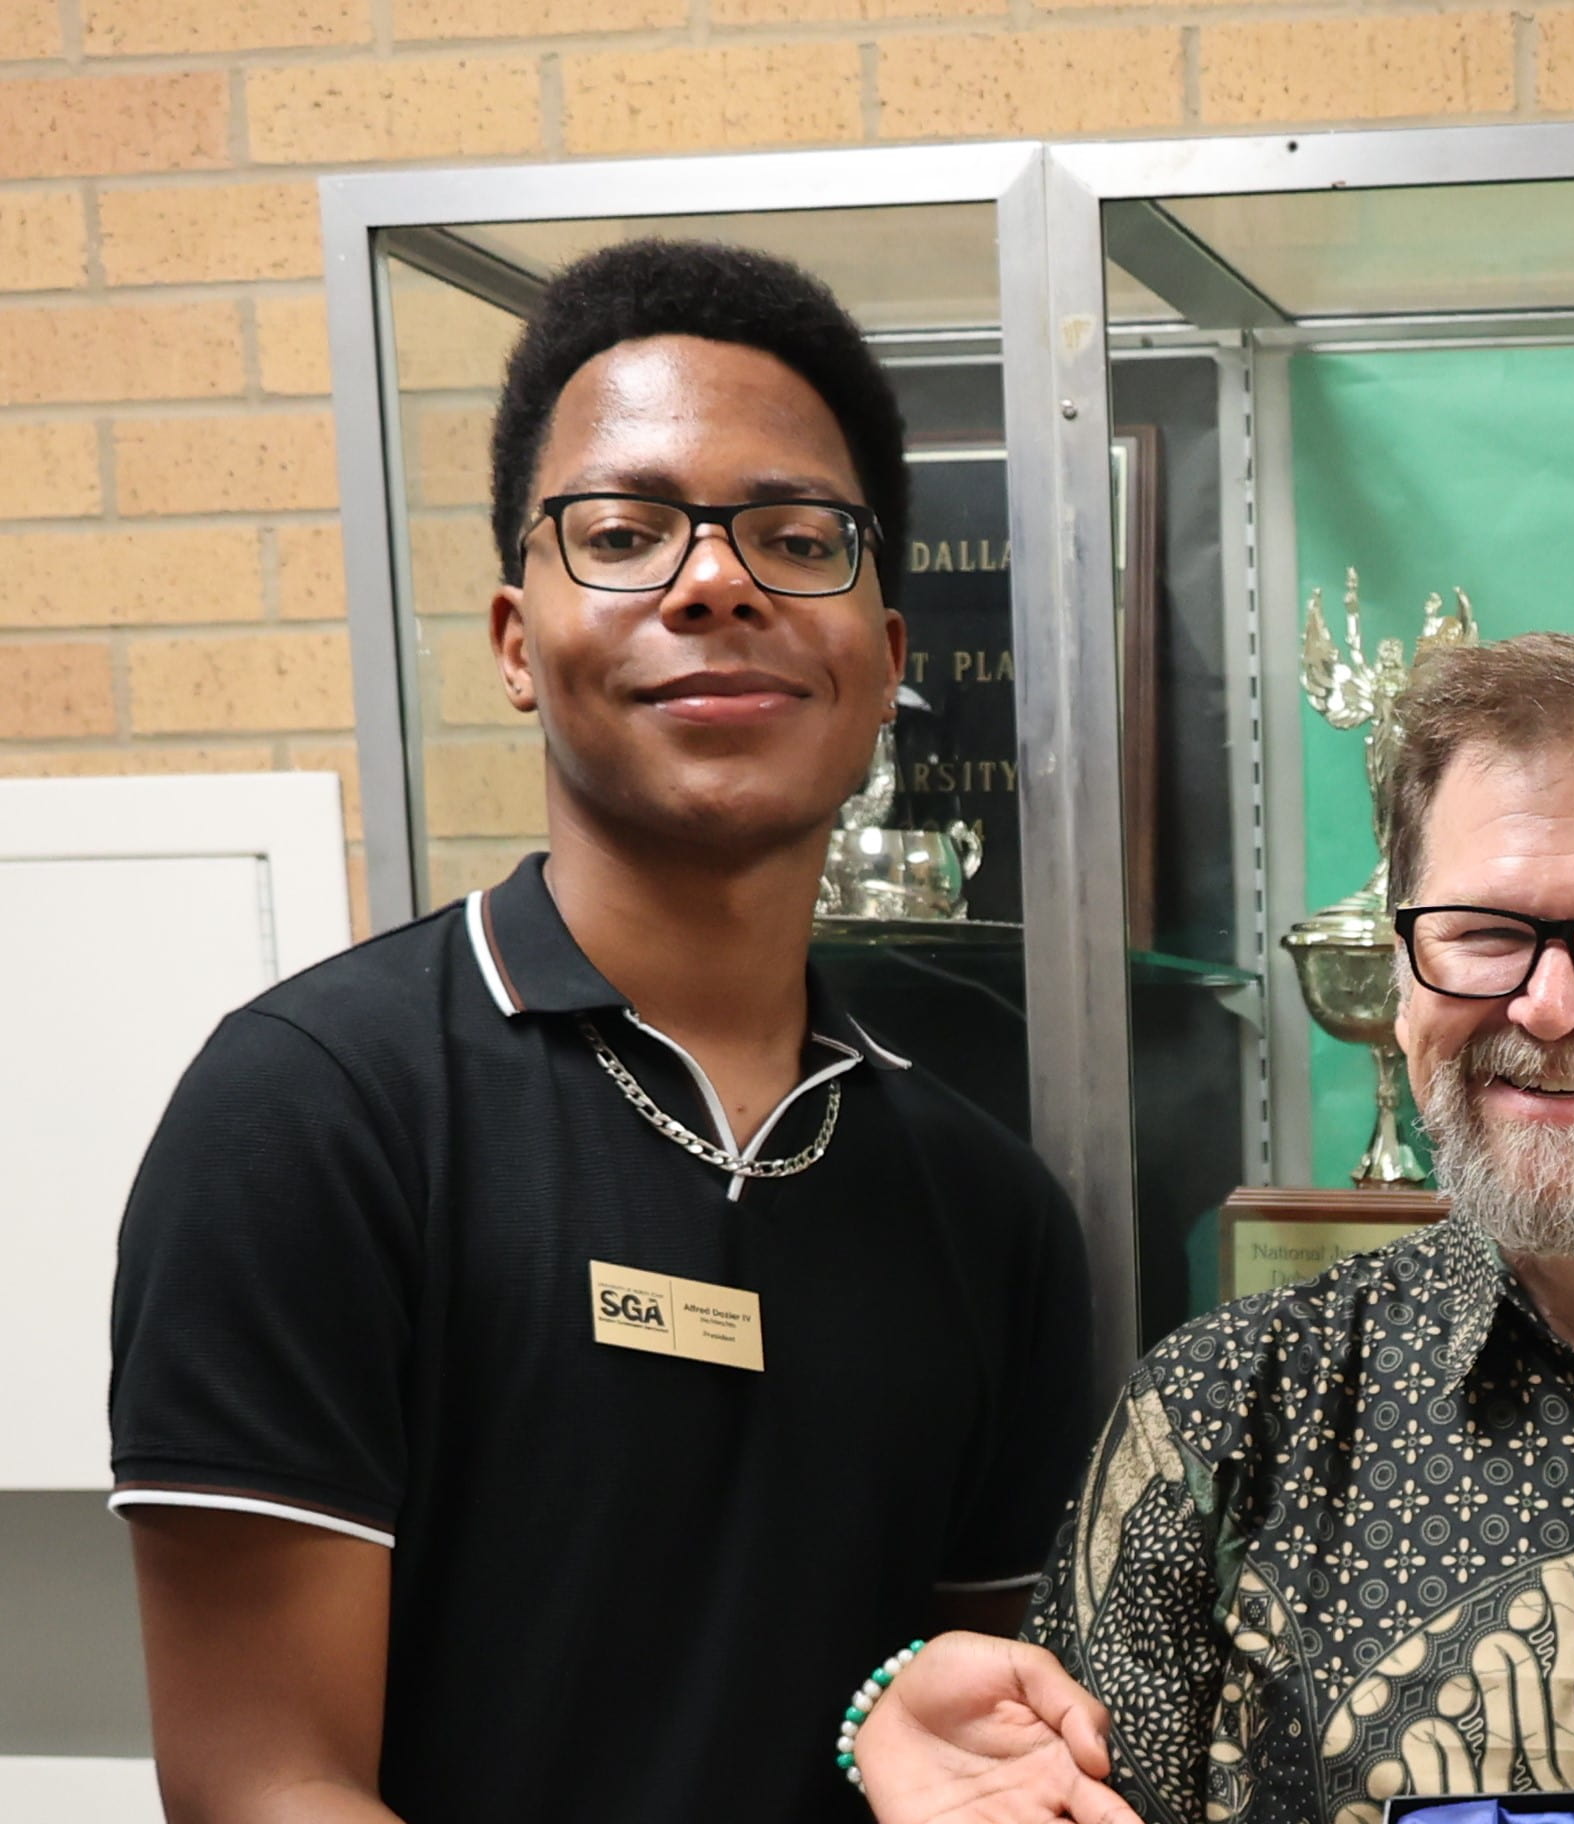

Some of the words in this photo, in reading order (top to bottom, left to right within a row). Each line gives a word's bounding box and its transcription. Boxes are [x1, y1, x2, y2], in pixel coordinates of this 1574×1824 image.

[911, 539, 1011, 572] DALLA
[953, 651, 1014, 682] PLA
[897, 761, 1017, 792] RSITY
[1252, 1243, 1326, 1261] National
[600, 1289, 665, 1328] SGA
